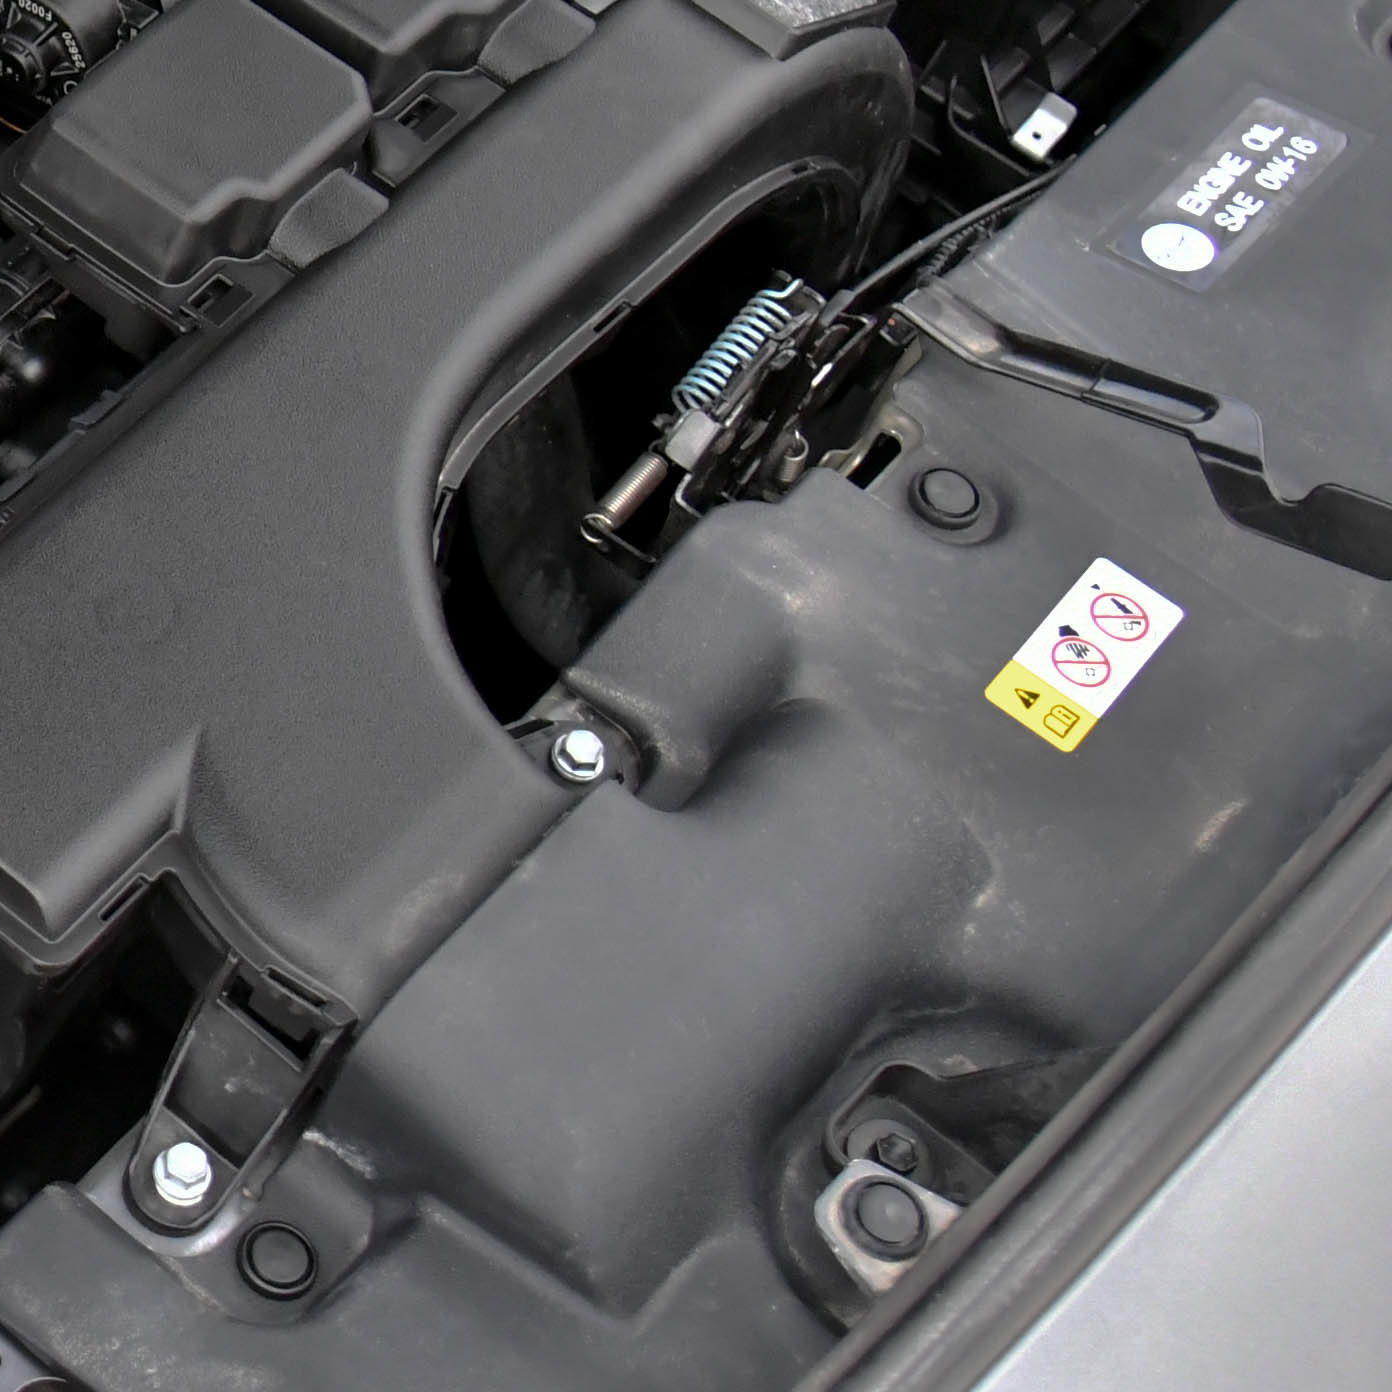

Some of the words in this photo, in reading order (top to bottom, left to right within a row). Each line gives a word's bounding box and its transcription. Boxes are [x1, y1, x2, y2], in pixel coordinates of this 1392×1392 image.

[1177, 151, 1252, 217] ENGINE
[1241, 123, 1285, 152] OIL
[1214, 191, 1265, 232] SAE
[1255, 136, 1318, 191] 0W-16
